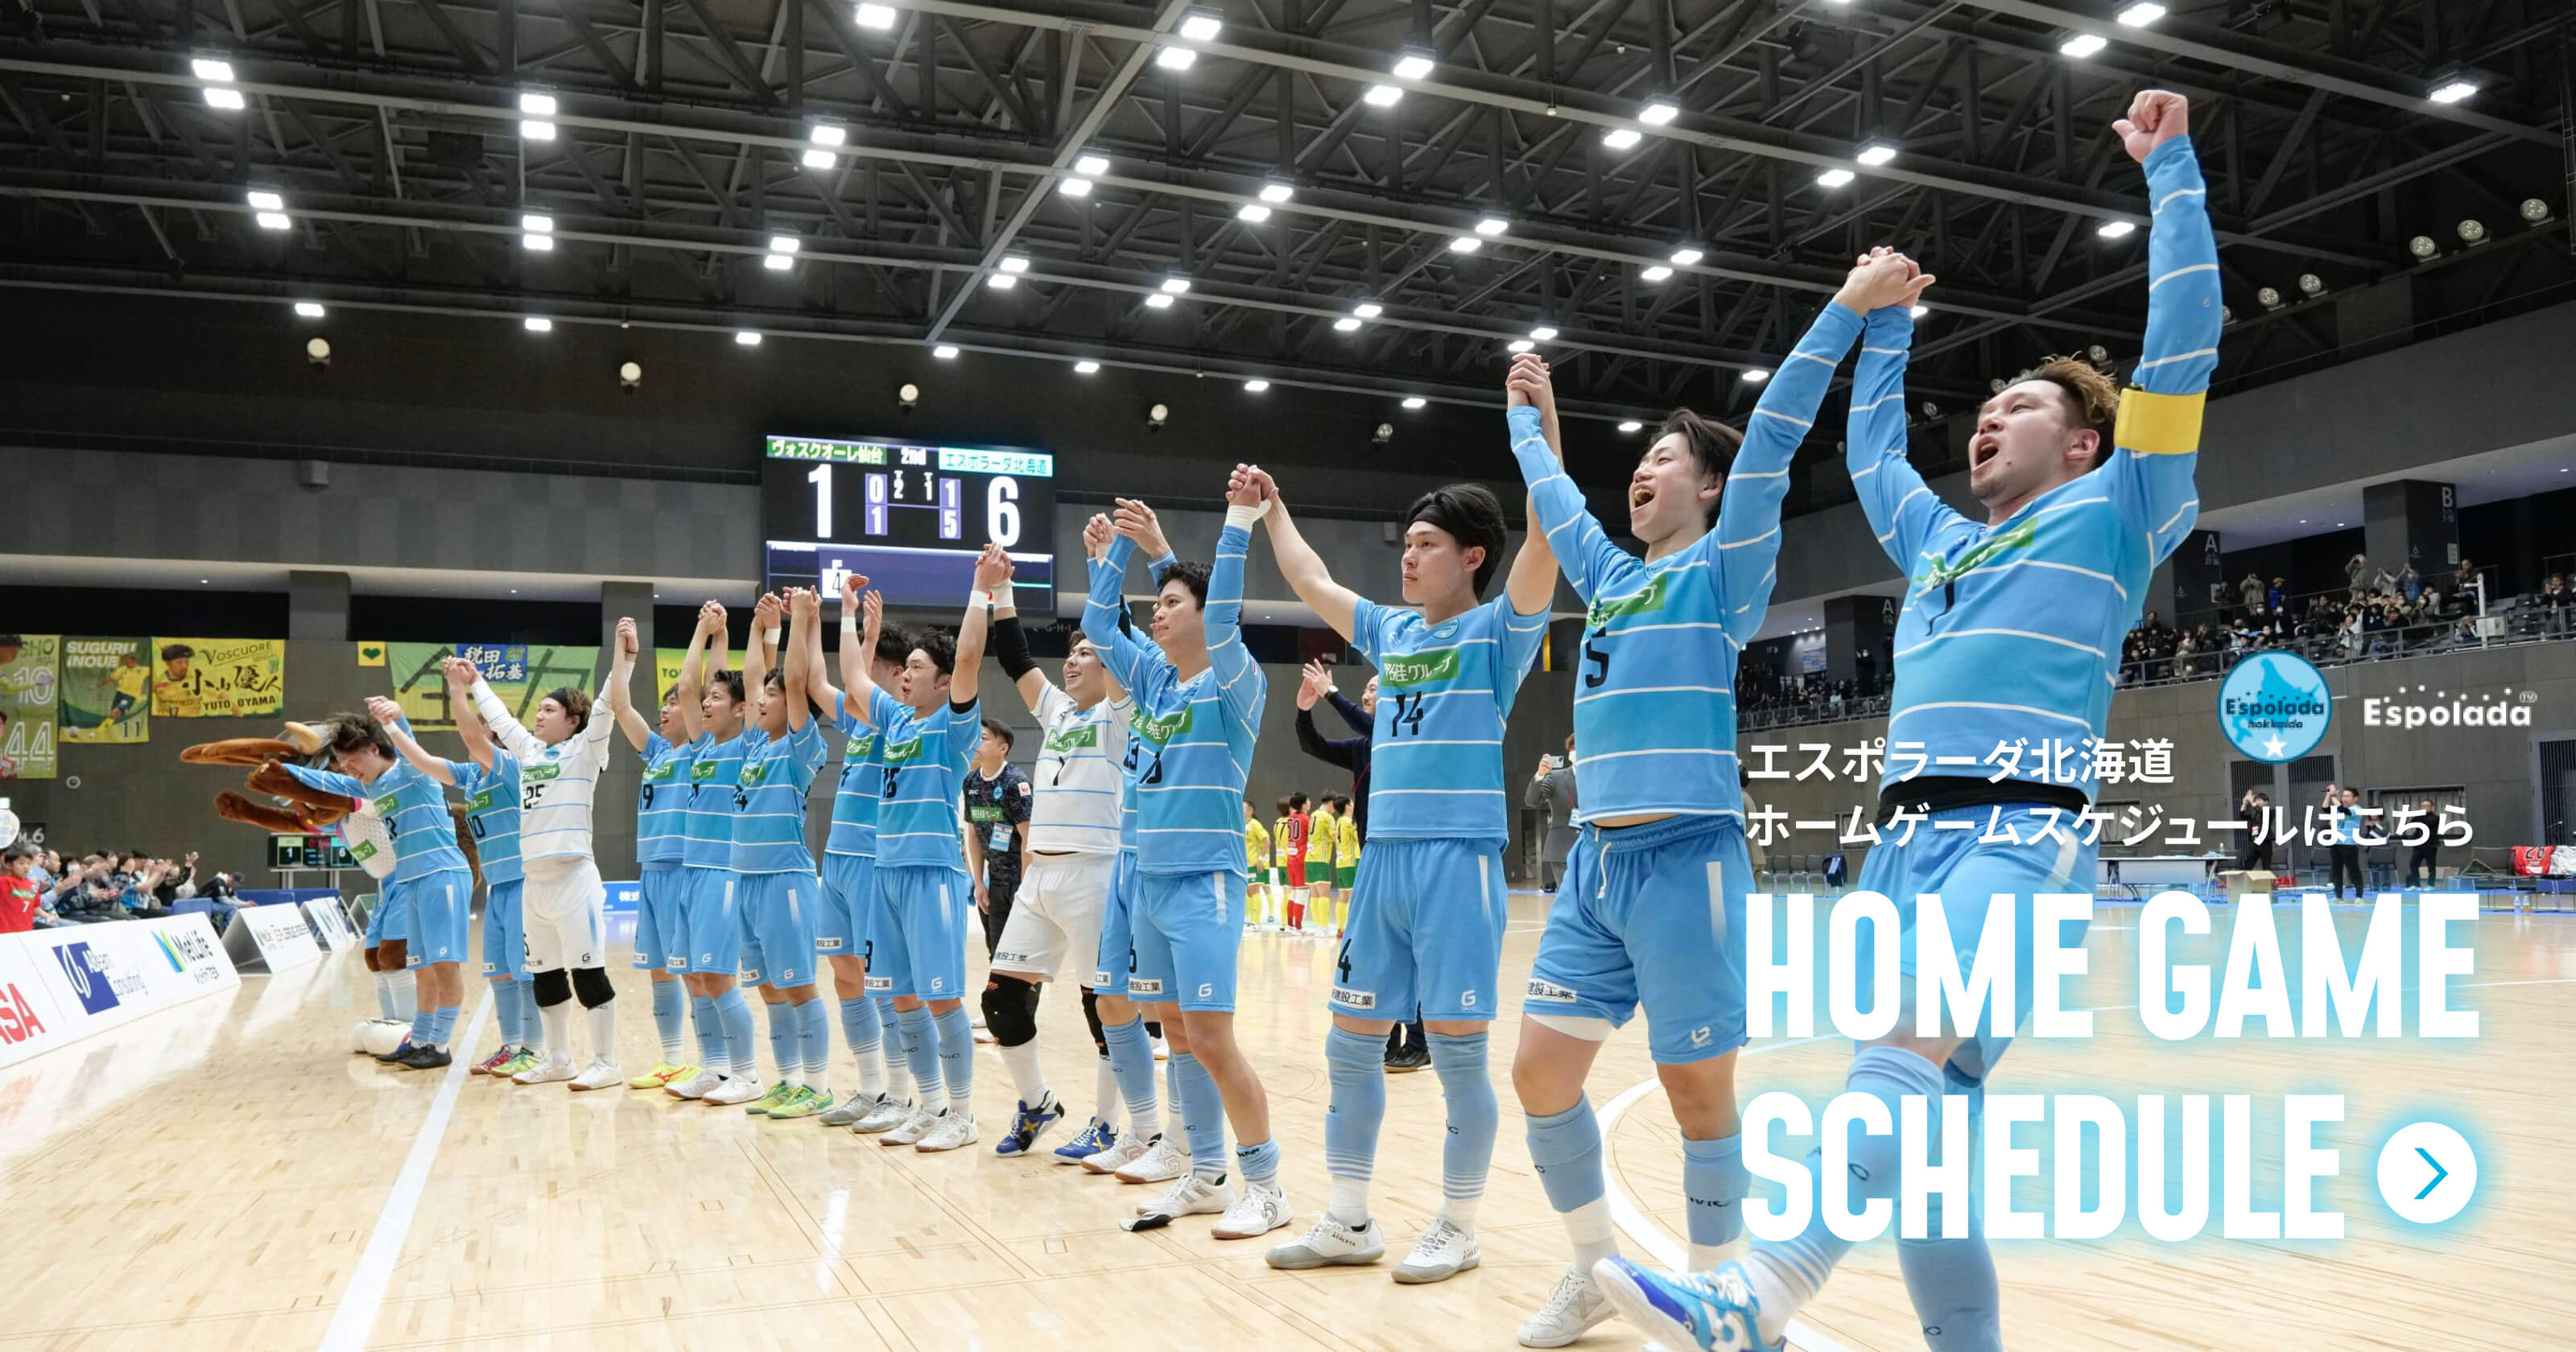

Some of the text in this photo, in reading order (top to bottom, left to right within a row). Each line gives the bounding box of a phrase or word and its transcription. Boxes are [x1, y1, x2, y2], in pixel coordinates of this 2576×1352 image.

[771, 440, 883, 464] ヴォスクオーレ仙台
[900, 447, 927, 466] 2nd
[946, 454, 1048, 475] エスポラーダ北海道
[869, 475, 884, 503] 0
[894, 479, 903, 499] 2
[925, 480, 932, 501] 1
[944, 480, 956, 508] 1
[2442, 486, 2454, 508] B
[808, 464, 832, 538] 1
[987, 476, 1021, 548] 6
[871, 505, 882, 534] 1
[943, 510, 957, 538] 5
[2205, 534, 2218, 553] A
[1882, 599, 1894, 615] A
[1585, 626, 1609, 688] 5
[662, 668, 682, 678] TO
[203, 700, 231, 711] YUTO
[237, 695, 276, 707] OYAMA
[0, 983, 46, 1045] SA
